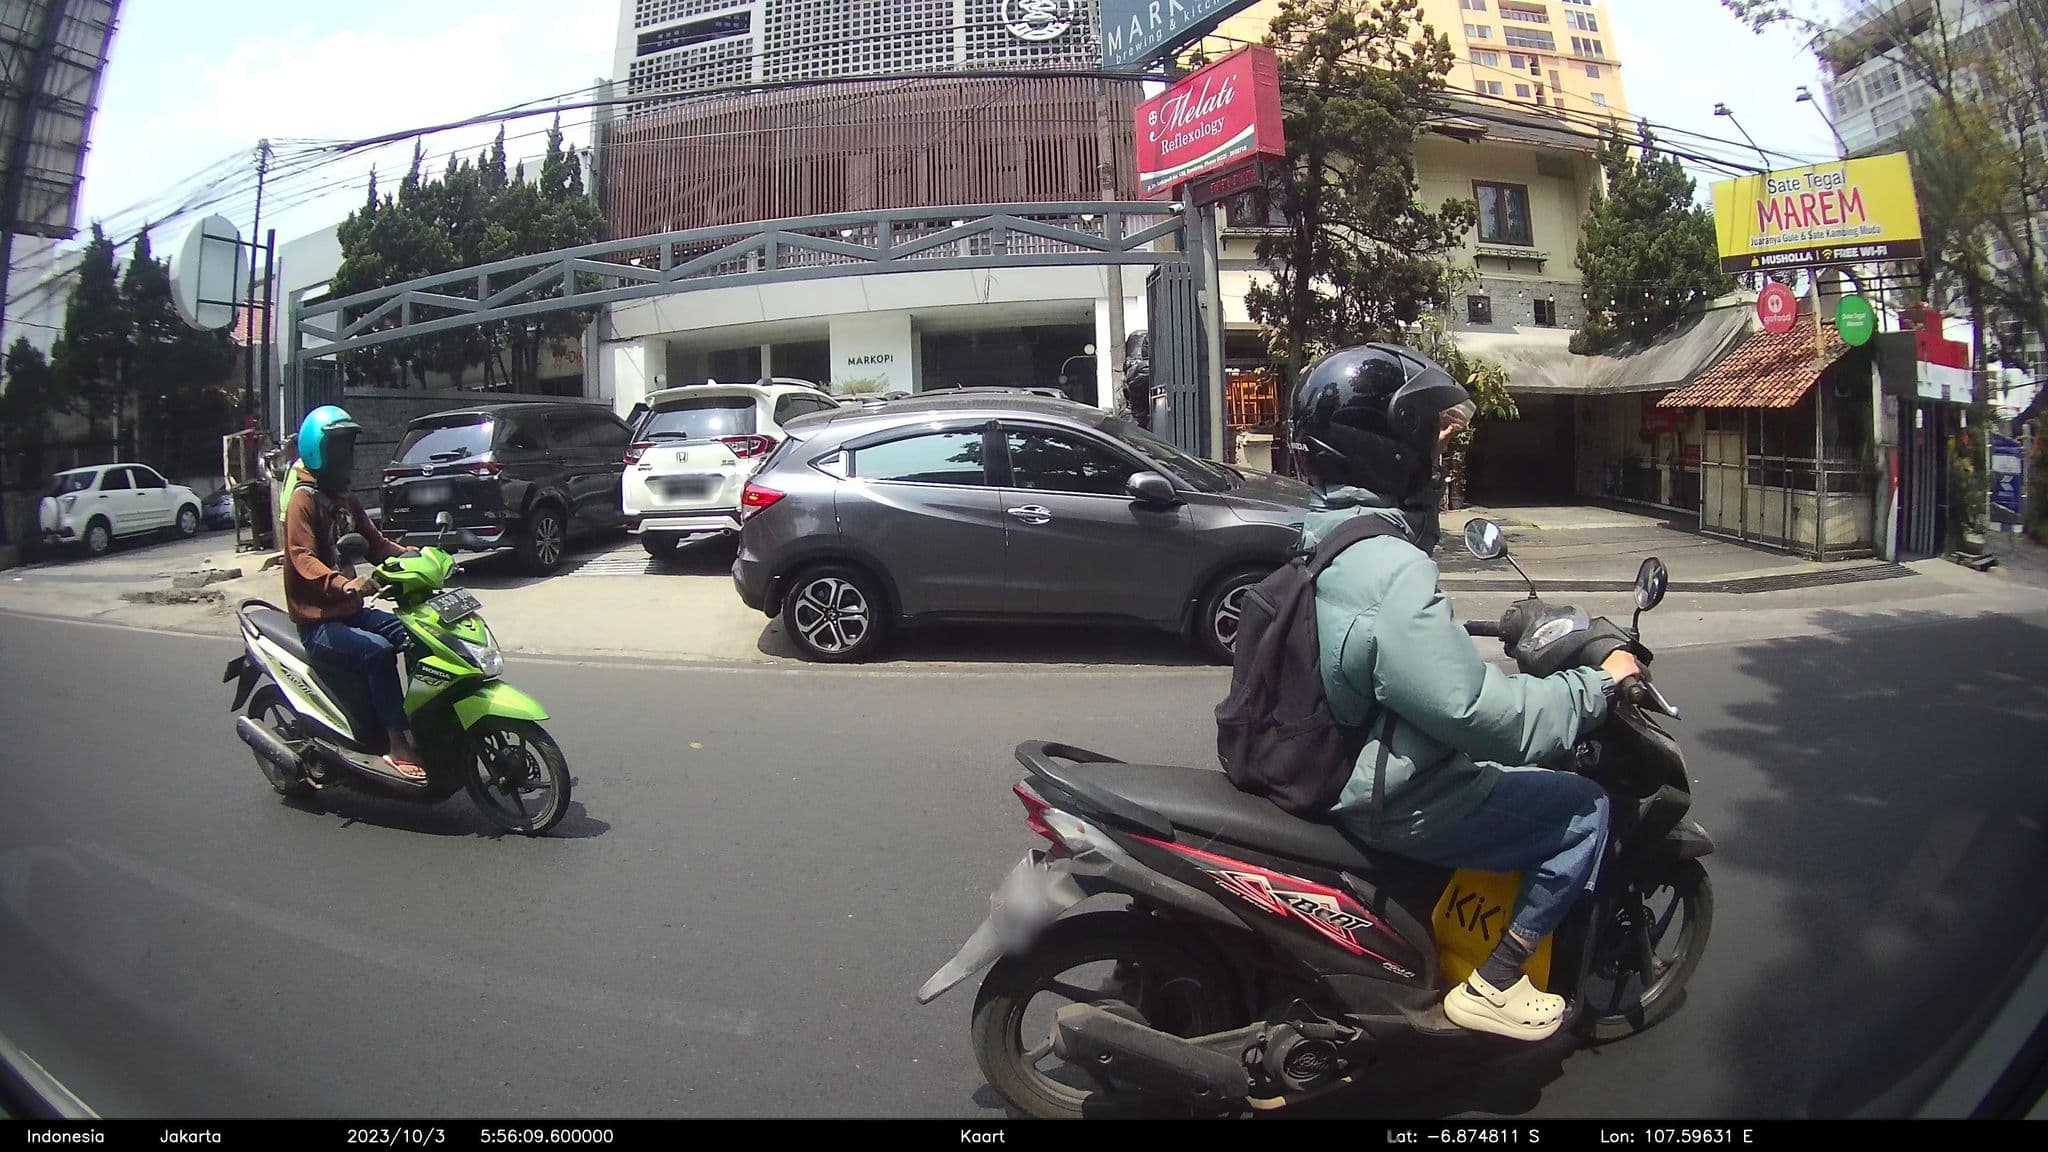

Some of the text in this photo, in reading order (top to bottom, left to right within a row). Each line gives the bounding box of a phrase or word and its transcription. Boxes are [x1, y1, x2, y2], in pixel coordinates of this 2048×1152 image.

[1116, 30, 1163, 64] brewing
[1169, 19, 1177, 31] &
[1150, 74, 1237, 142] Melati
[1160, 117, 1225, 155] Reflexology
[1767, 168, 1846, 194] Sate Tegal
[1756, 187, 1866, 233] MAREM
[1808, 230, 1825, 240] Sate
[1826, 227, 1859, 238] Kambing
[1761, 245, 1888, 265] MUSHOLLA FREE WI-FI
[847, 354, 894, 366] MARKOPI
[422, 666, 451, 680] HONDA
